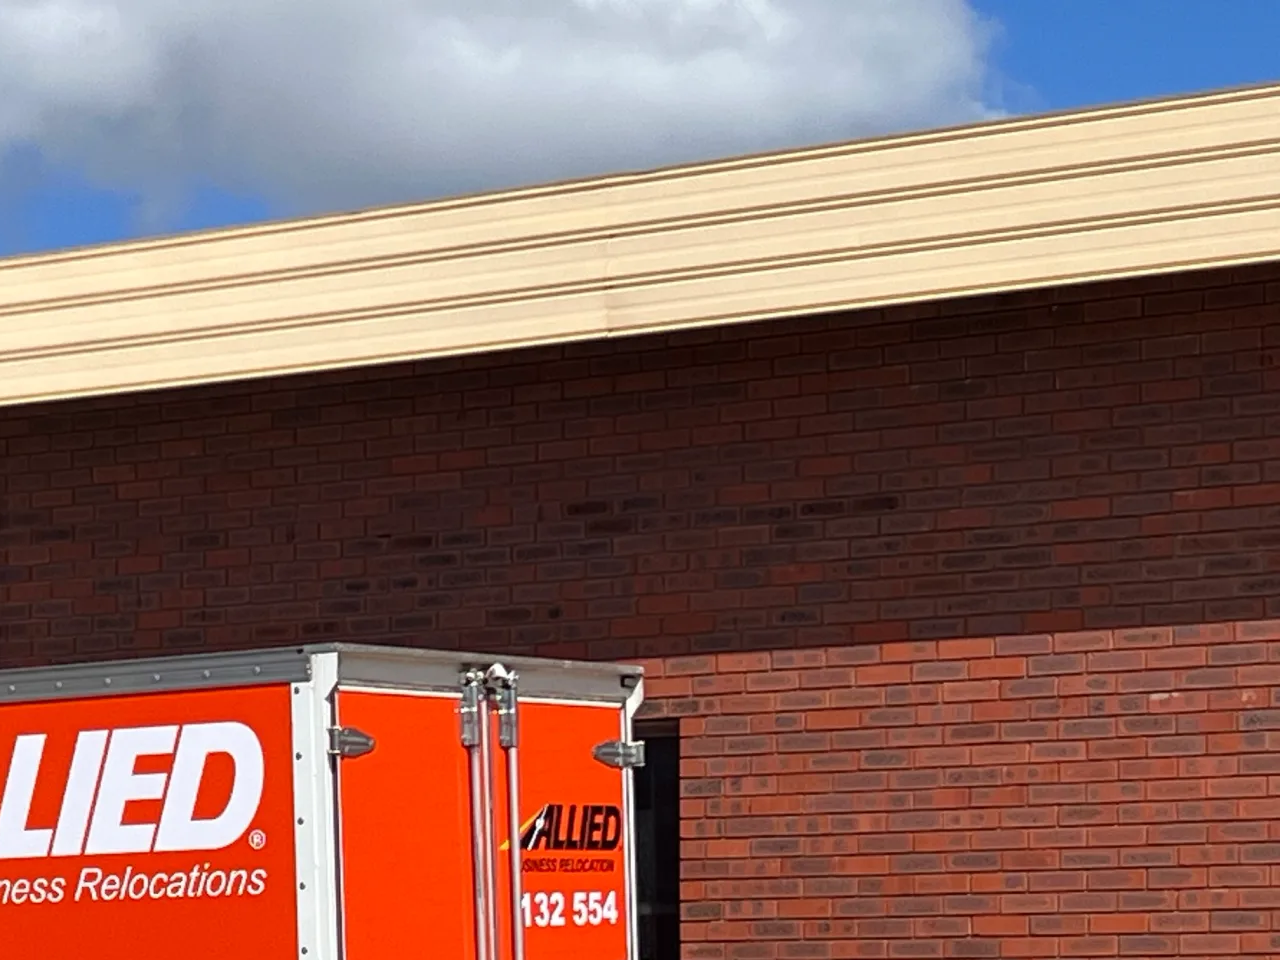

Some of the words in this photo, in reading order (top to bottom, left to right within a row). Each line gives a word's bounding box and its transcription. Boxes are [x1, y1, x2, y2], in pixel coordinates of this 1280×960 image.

[520, 804, 621, 851] ALLIED
[75, 862, 267, 902] Relocations
[520, 891, 566, 927] 132
[572, 890, 619, 926] 554
